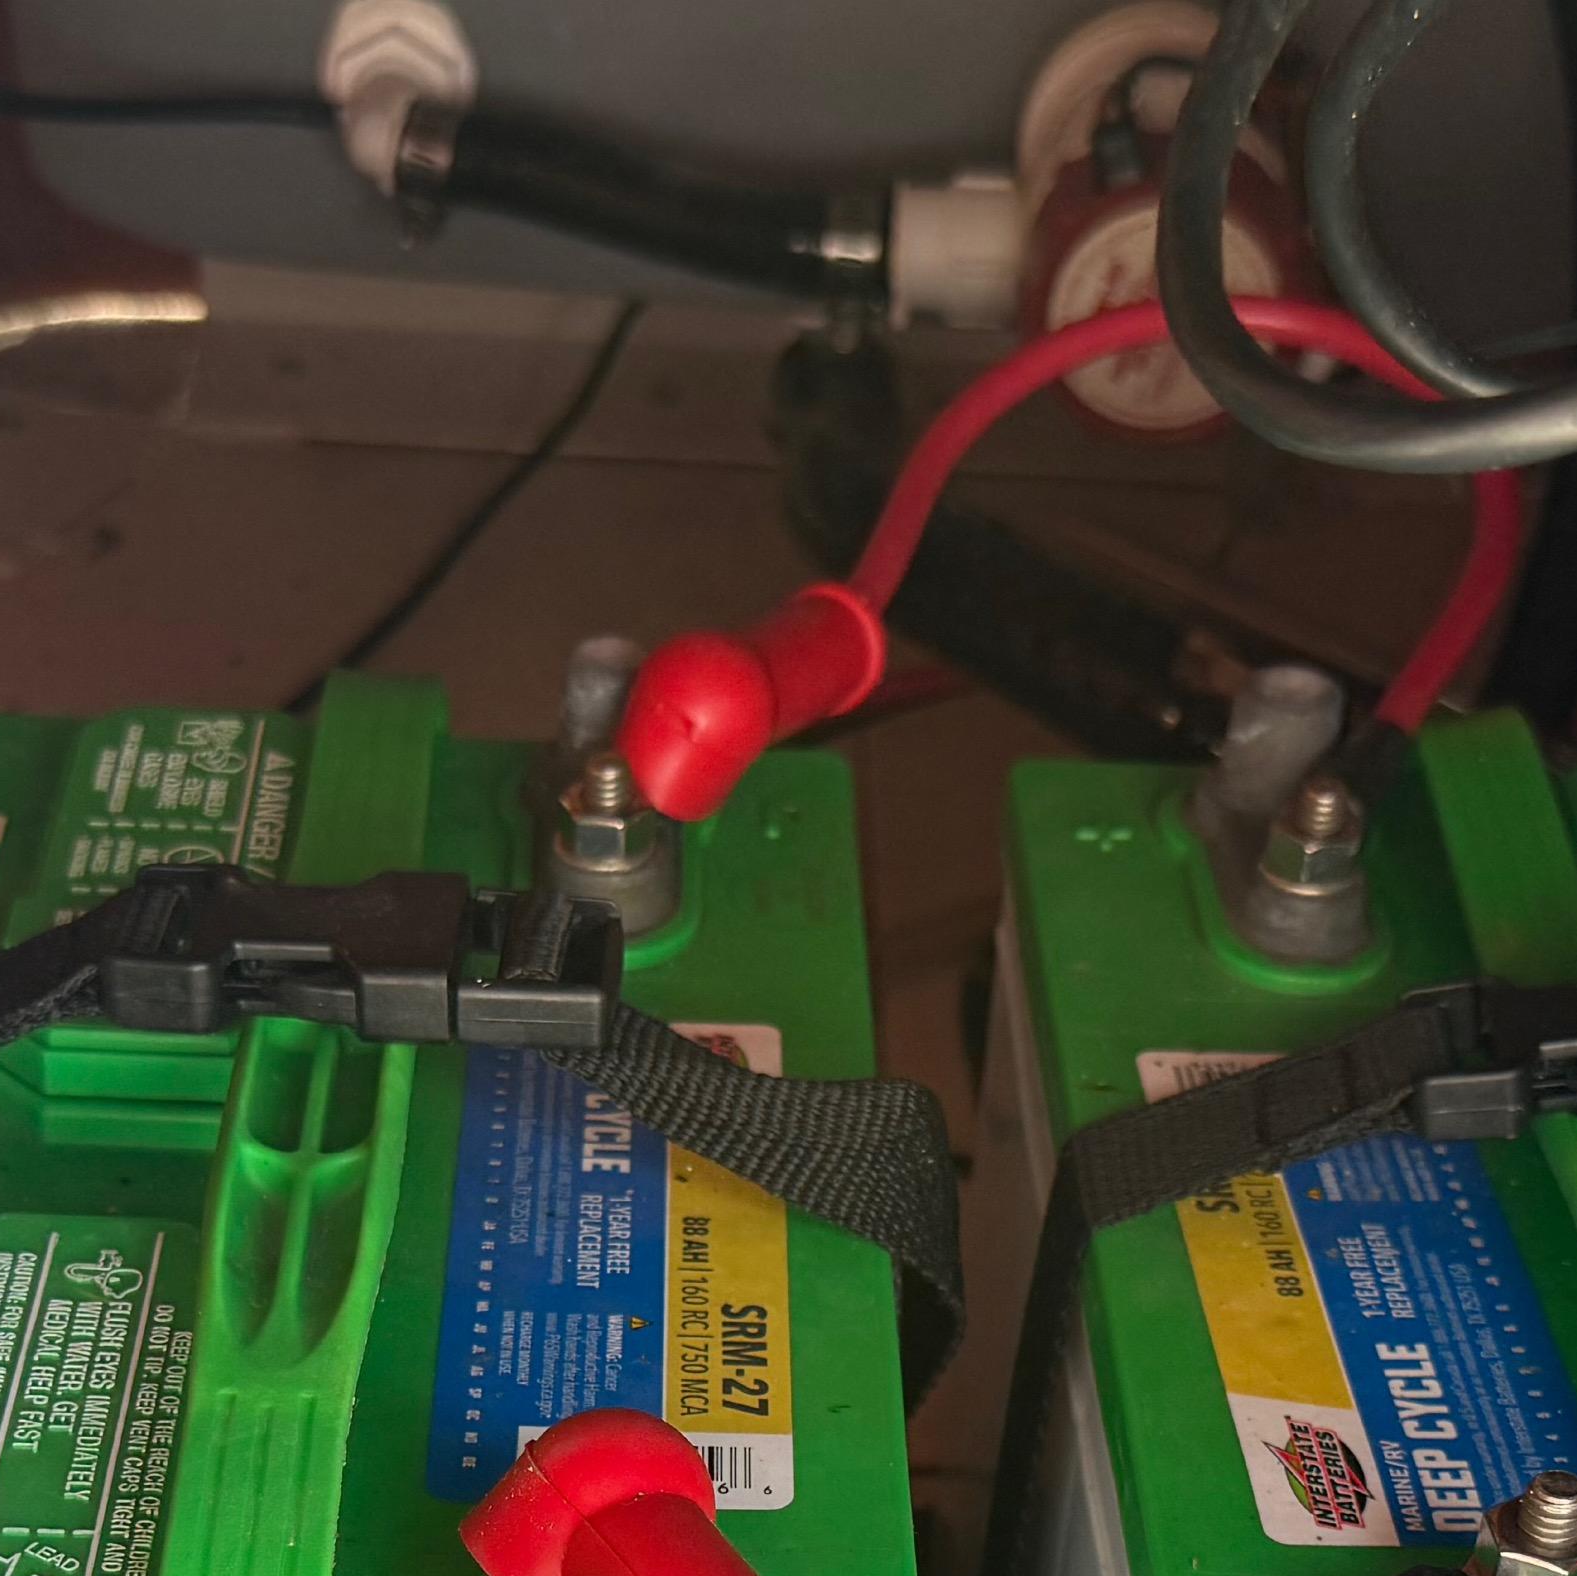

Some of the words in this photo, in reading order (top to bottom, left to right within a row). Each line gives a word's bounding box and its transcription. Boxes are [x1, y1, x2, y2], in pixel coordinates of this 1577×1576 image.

[248, 776, 287, 858] DANGER
[1245, 1189, 1275, 1207] RC
[607, 1196, 629, 1237] 1-YEAR
[682, 1217, 708, 1235] 88
[1252, 1211, 1284, 1237] 160
[576, 1194, 602, 1287] REPLACEMENT
[682, 1240, 708, 1261] AH
[1337, 1237, 1369, 1267] FREE
[606, 1242, 629, 1273] FREE
[1266, 1249, 1295, 1271] AH
[1362, 1224, 1414, 1318] REPLACEMENT
[6, 1252, 37, 1303] CAUTION:
[682, 1277, 708, 1303] 160
[1273, 1275, 1304, 1296] 88
[1349, 1271, 1385, 1317] 1-YEAR
[70, 1301, 102, 1335] WITH
[98, 1301, 132, 1347] FLUSH
[152, 1305, 174, 1321] DO
[501, 1311, 514, 1332] WHEN
[565, 1313, 580, 1334] Wash
[585, 1314, 600, 1328] and
[682, 1310, 708, 1329] RC
[33, 1300, 72, 1360] MEDICAL
[147, 1326, 170, 1351] NOT
[500, 1334, 513, 1349] NOT
[518, 1311, 532, 1349] RECHARGE
[605, 1314, 623, 1361] WARNING:
[168, 1332, 192, 1361] KEEP
[563, 1336, 579, 1360] hands
[582, 1330, 599, 1381] Reproductive
[682, 1343, 708, 1371] 750
[721, 1304, 768, 1415] SRM-27
[56, 1342, 92, 1395] WATER.
[88, 1352, 120, 1388] EYES
[141, 1356, 164, 1378] TIP.
[162, 1366, 186, 1390] OUT
[516, 1350, 530, 1385] MONTHLY
[562, 1362, 578, 1380] after
[603, 1363, 622, 1391] Cancer
[23, 1366, 56, 1405] HELP
[134, 1383, 158, 1415] KEEP
[680, 1379, 708, 1415] MCA
[1376, 1343, 1456, 1438] CYCLE
[47, 1401, 78, 1432] GET
[157, 1396, 180, 1413] OF
[11, 1411, 45, 1452] FAST
[126, 1420, 151, 1451] VENT
[150, 1419, 176, 1444] THE
[64, 1395, 110, 1500] IMMEDIATELY
[117, 1457, 143, 1492] CAPS
[142, 1448, 169, 1492] REACH
[1289, 1423, 1336, 1527] INTERSTATE
[1315, 1430, 1359, 1524] BATTERIES
[1380, 1440, 1423, 1531] MARINE/RV
[763, 1486, 773, 1496] 6
[1413, 1448, 1488, 1531] DEEP
[109, 1499, 135, 1537] TIGHT
[138, 1498, 160, 1515] OF
[22, 1540, 80, 1573] LEAD
[100, 1543, 126, 1572] AND
